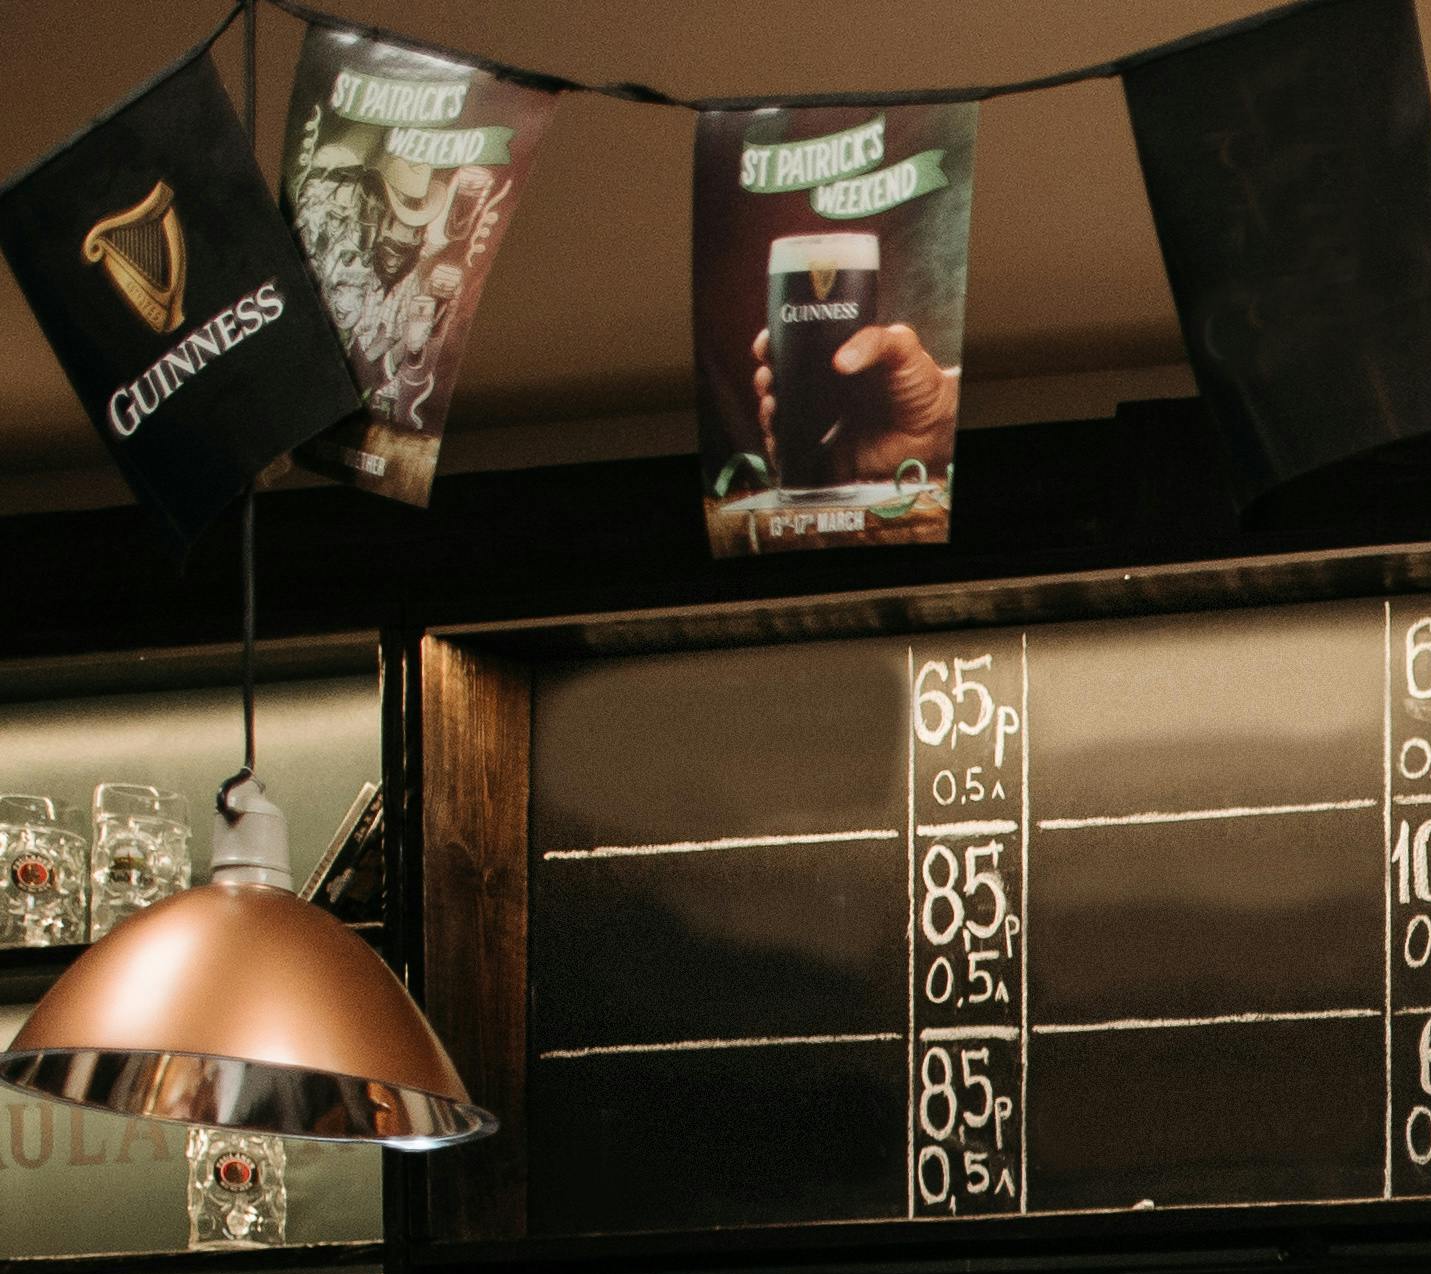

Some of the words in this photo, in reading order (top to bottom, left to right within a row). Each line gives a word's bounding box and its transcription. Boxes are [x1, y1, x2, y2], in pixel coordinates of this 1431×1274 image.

[332, 72, 353, 111] ST
[360, 77, 467, 121] PATRICK'S
[386, 127, 485, 164] WEEKEND
[740, 148, 770, 187] ST
[777, 123, 884, 187] PATRICK'S
[816, 163, 917, 216] WEEKEND
[780, 302, 860, 325] GUINNESS
[108, 282, 287, 437] GUINNESS
[817, 509, 865, 533] MARCH
